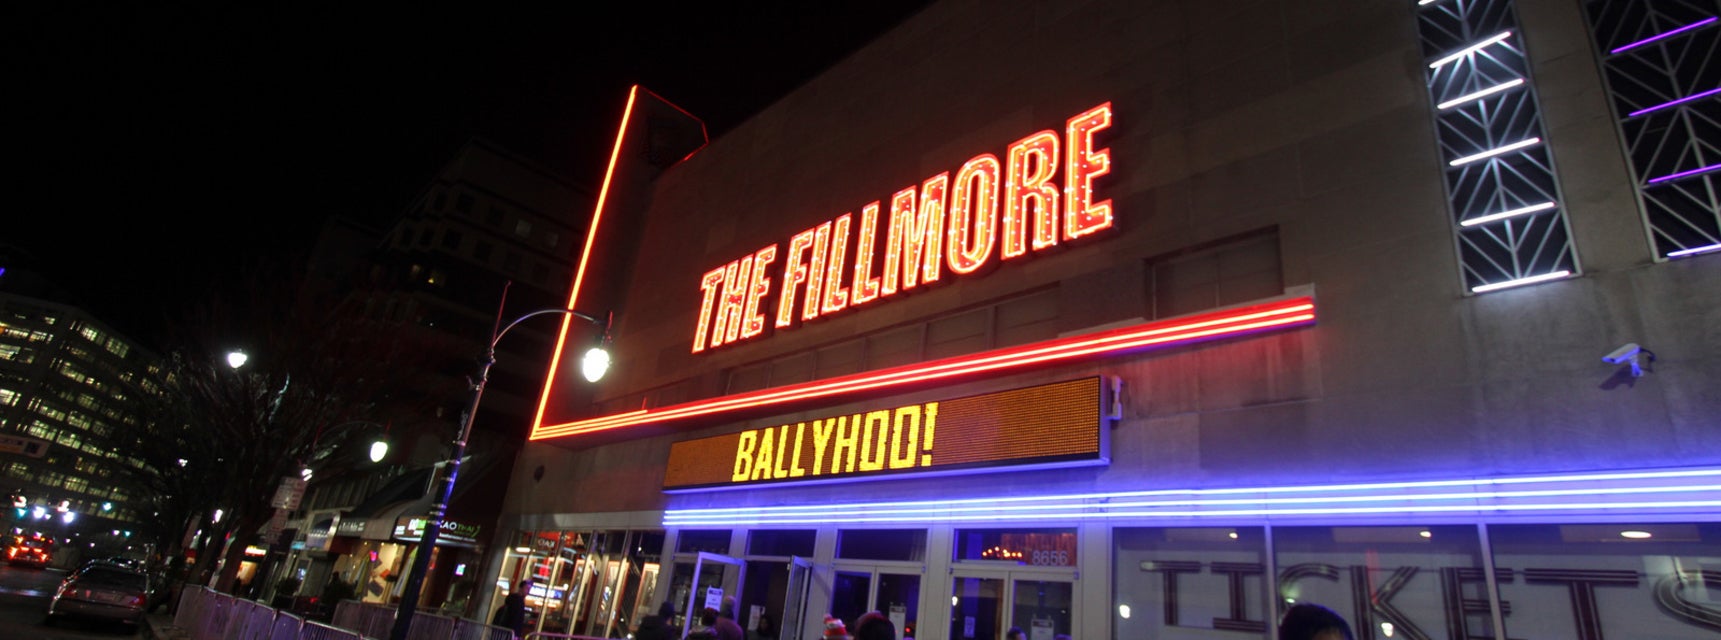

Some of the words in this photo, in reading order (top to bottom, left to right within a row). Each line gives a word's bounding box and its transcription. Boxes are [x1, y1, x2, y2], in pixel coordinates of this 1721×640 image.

[692, 243, 777, 353] THE
[775, 101, 1113, 330] FILLMORE
[732, 402, 939, 482] BALLYHOO!
[1032, 550, 1068, 566] 8656
